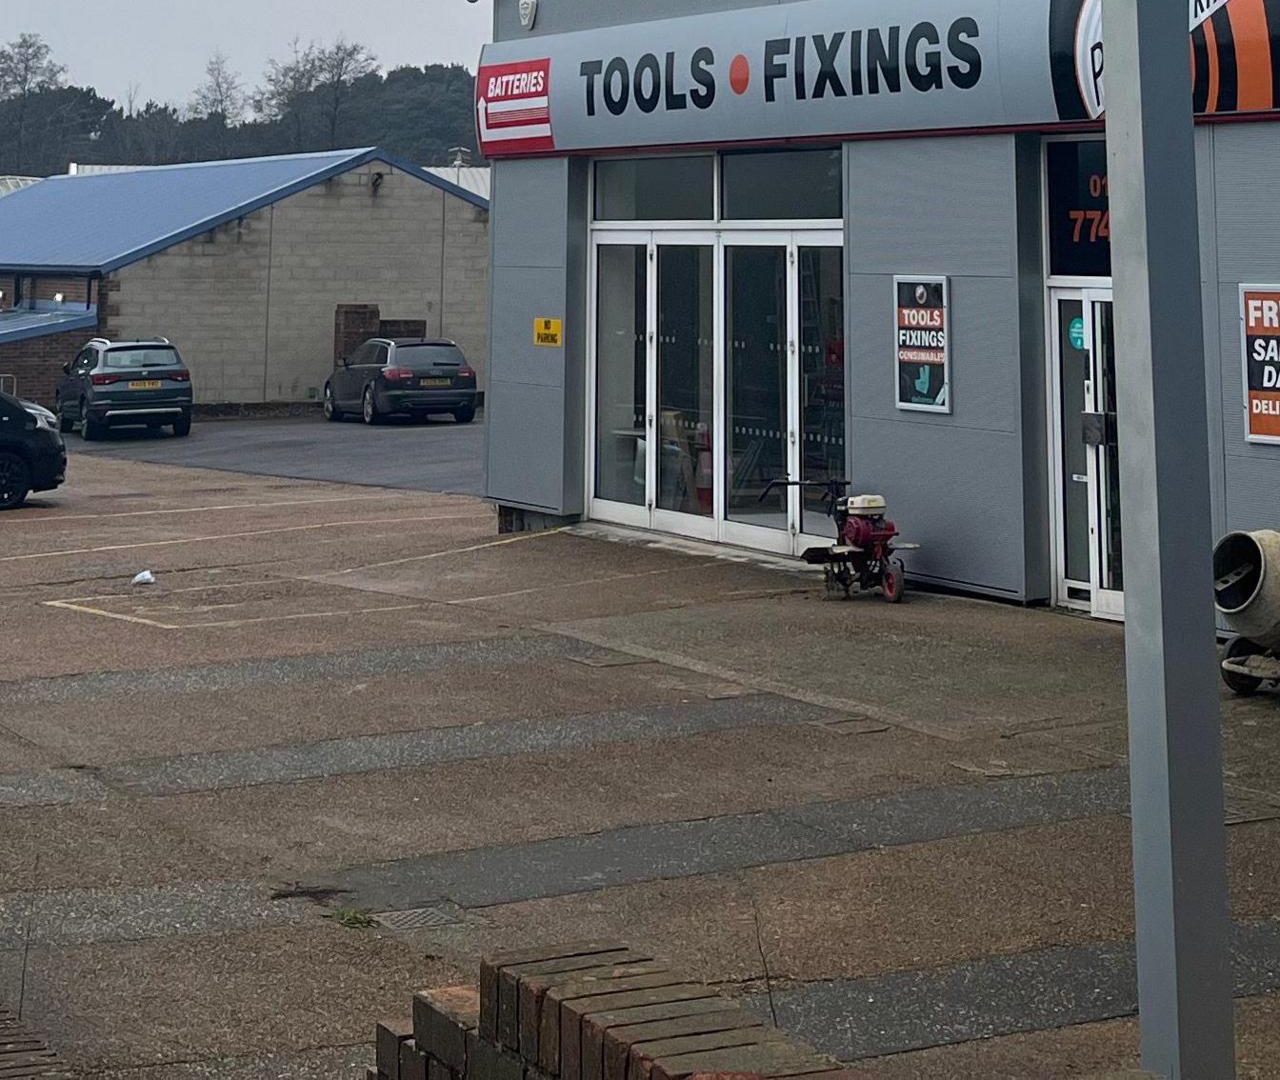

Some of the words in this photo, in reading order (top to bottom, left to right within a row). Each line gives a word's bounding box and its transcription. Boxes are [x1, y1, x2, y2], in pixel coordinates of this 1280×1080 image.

[580, 46, 716, 117] TOOLS
[764, 16, 983, 103] FIXINGS
[487, 70, 545, 98] BATTERIES
[902, 309, 941, 326] TOOLS
[899, 329, 945, 347] FIXINGS
